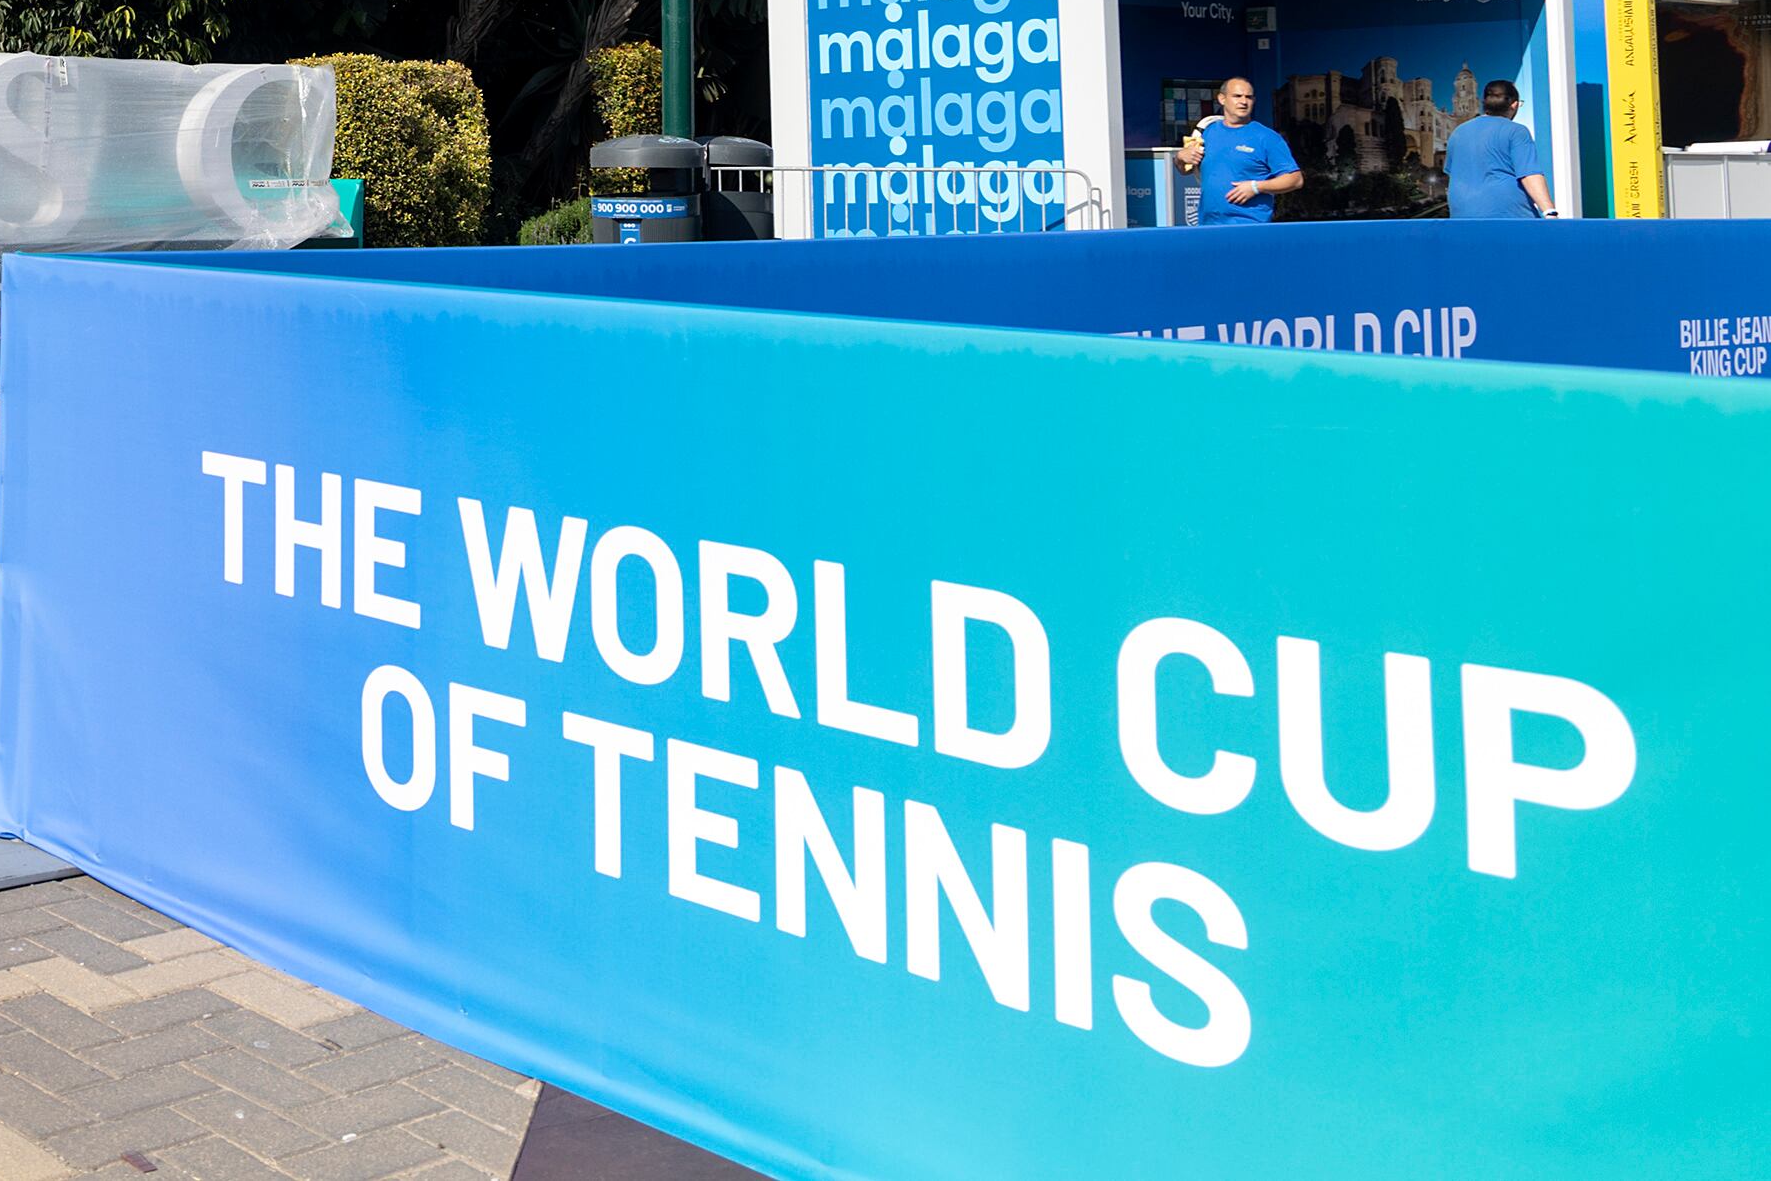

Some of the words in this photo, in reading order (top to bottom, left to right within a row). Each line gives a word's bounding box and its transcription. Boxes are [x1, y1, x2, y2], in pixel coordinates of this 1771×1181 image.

[1181, 1, 1208, 18] Your
[1209, 3, 1235, 23] City.
[597, 202, 613, 213] 900
[615, 203, 637, 213] 900
[639, 203, 664, 213] 000
[1680, 317, 1730, 348] BILLIE
[1732, 315, 1771, 345] JEAN
[1690, 348, 1732, 376] KING
[1734, 346, 1767, 376] CUP
[201, 450, 423, 630] THE
[457, 495, 1053, 771] WORLD
[1116, 615, 1639, 881] CUP
[360, 663, 527, 831] OF
[562, 714, 1253, 1069] TENNIS
